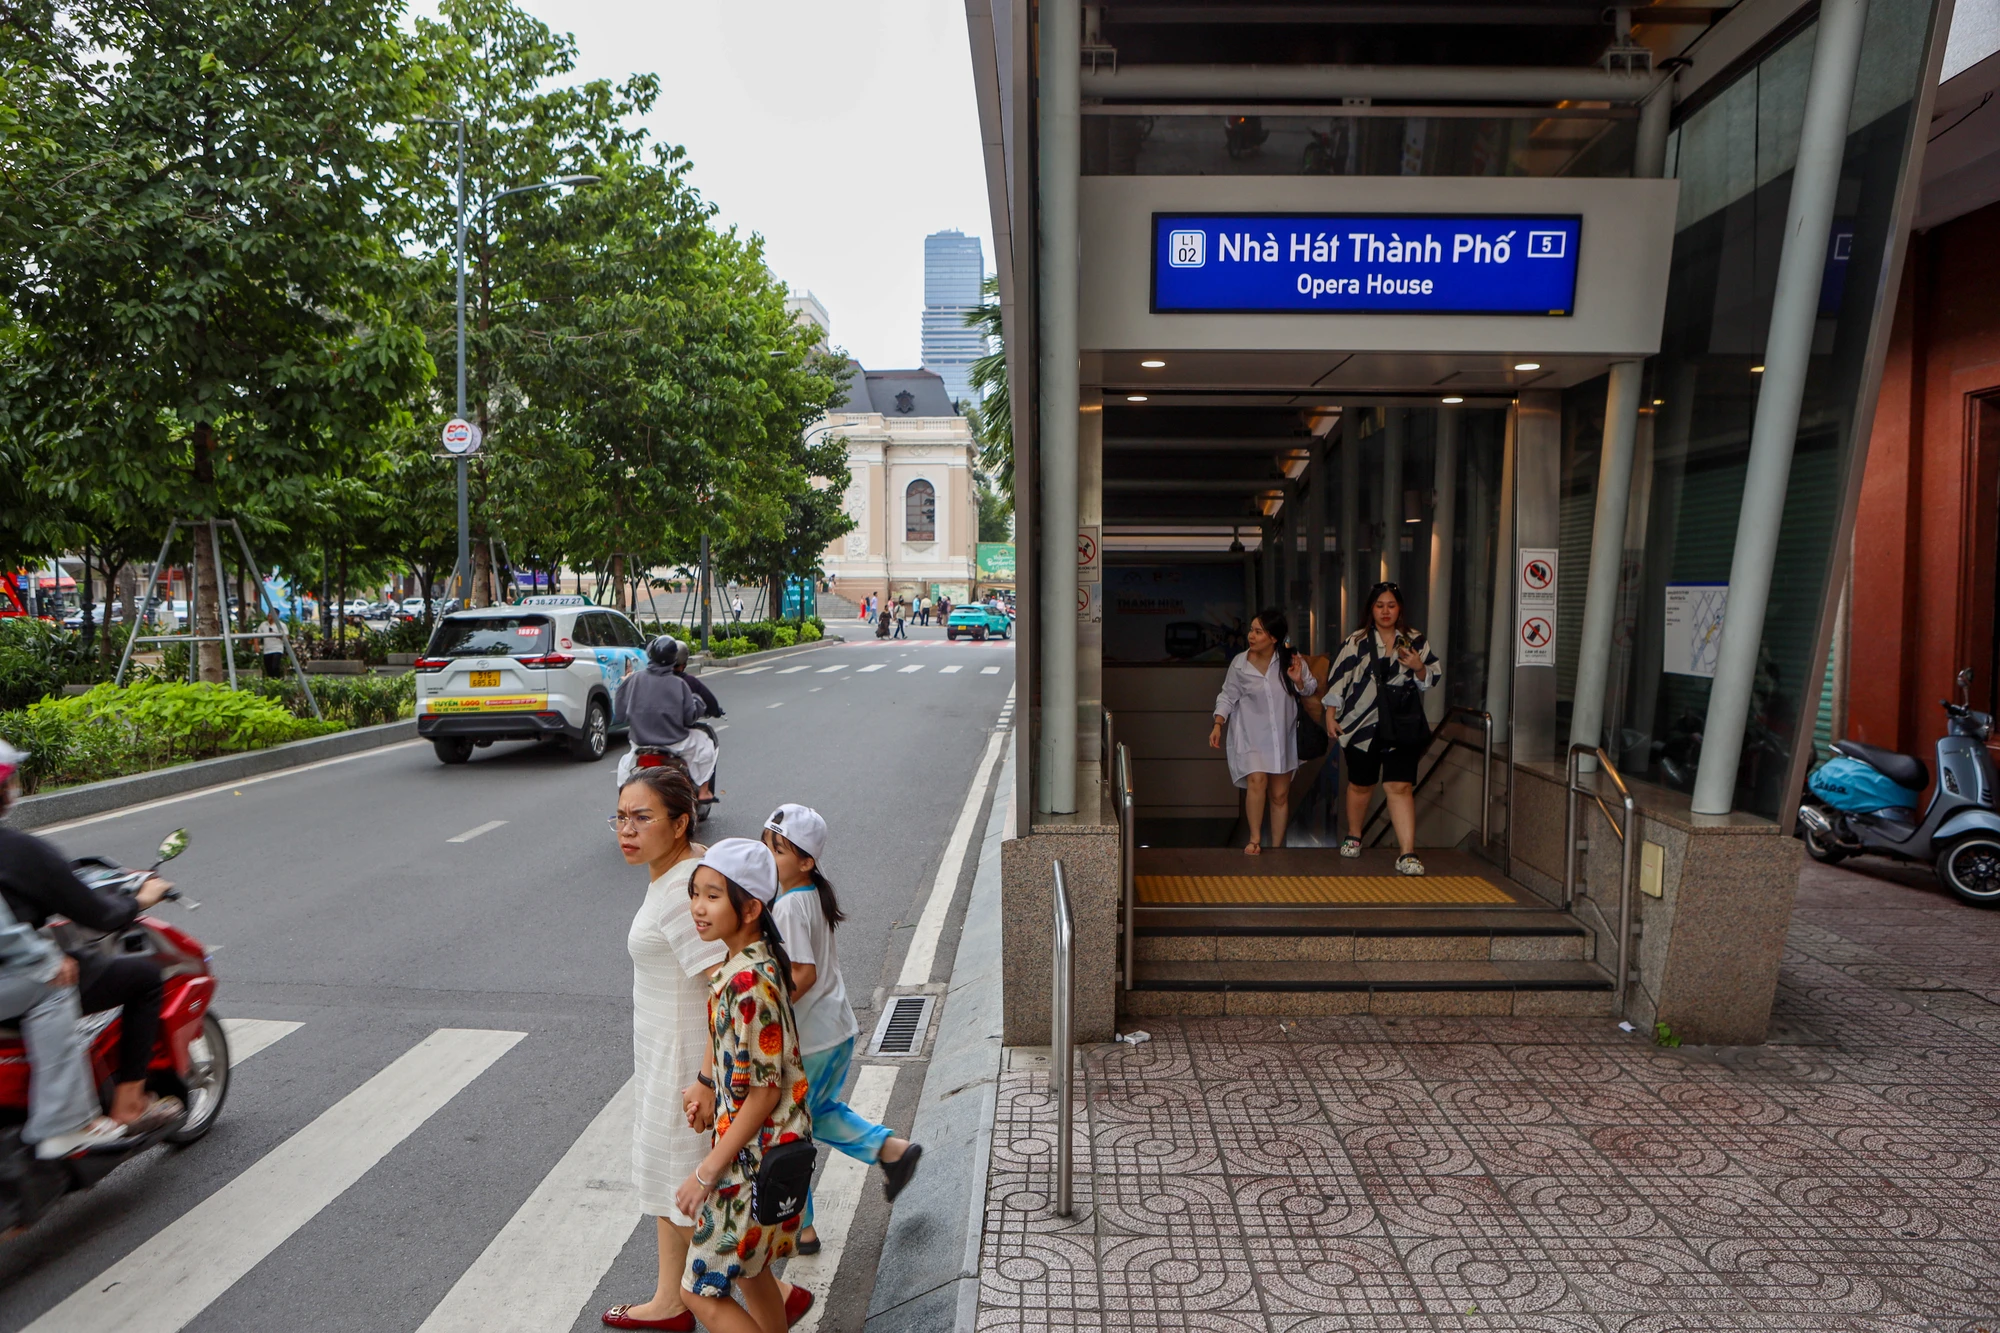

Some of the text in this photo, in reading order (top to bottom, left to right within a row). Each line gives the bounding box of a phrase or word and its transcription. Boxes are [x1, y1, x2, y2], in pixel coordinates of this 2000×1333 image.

[1182, 235, 1194, 246] L1
[1218, 230, 1517, 264] Nhà Hát Thành Phố
[1541, 237, 1552, 253] 5
[1178, 248, 1197, 263] 02
[1297, 273, 1434, 299] Opera House
[535, 598, 558, 606] 38.27
[571, 597, 581, 605] 27
